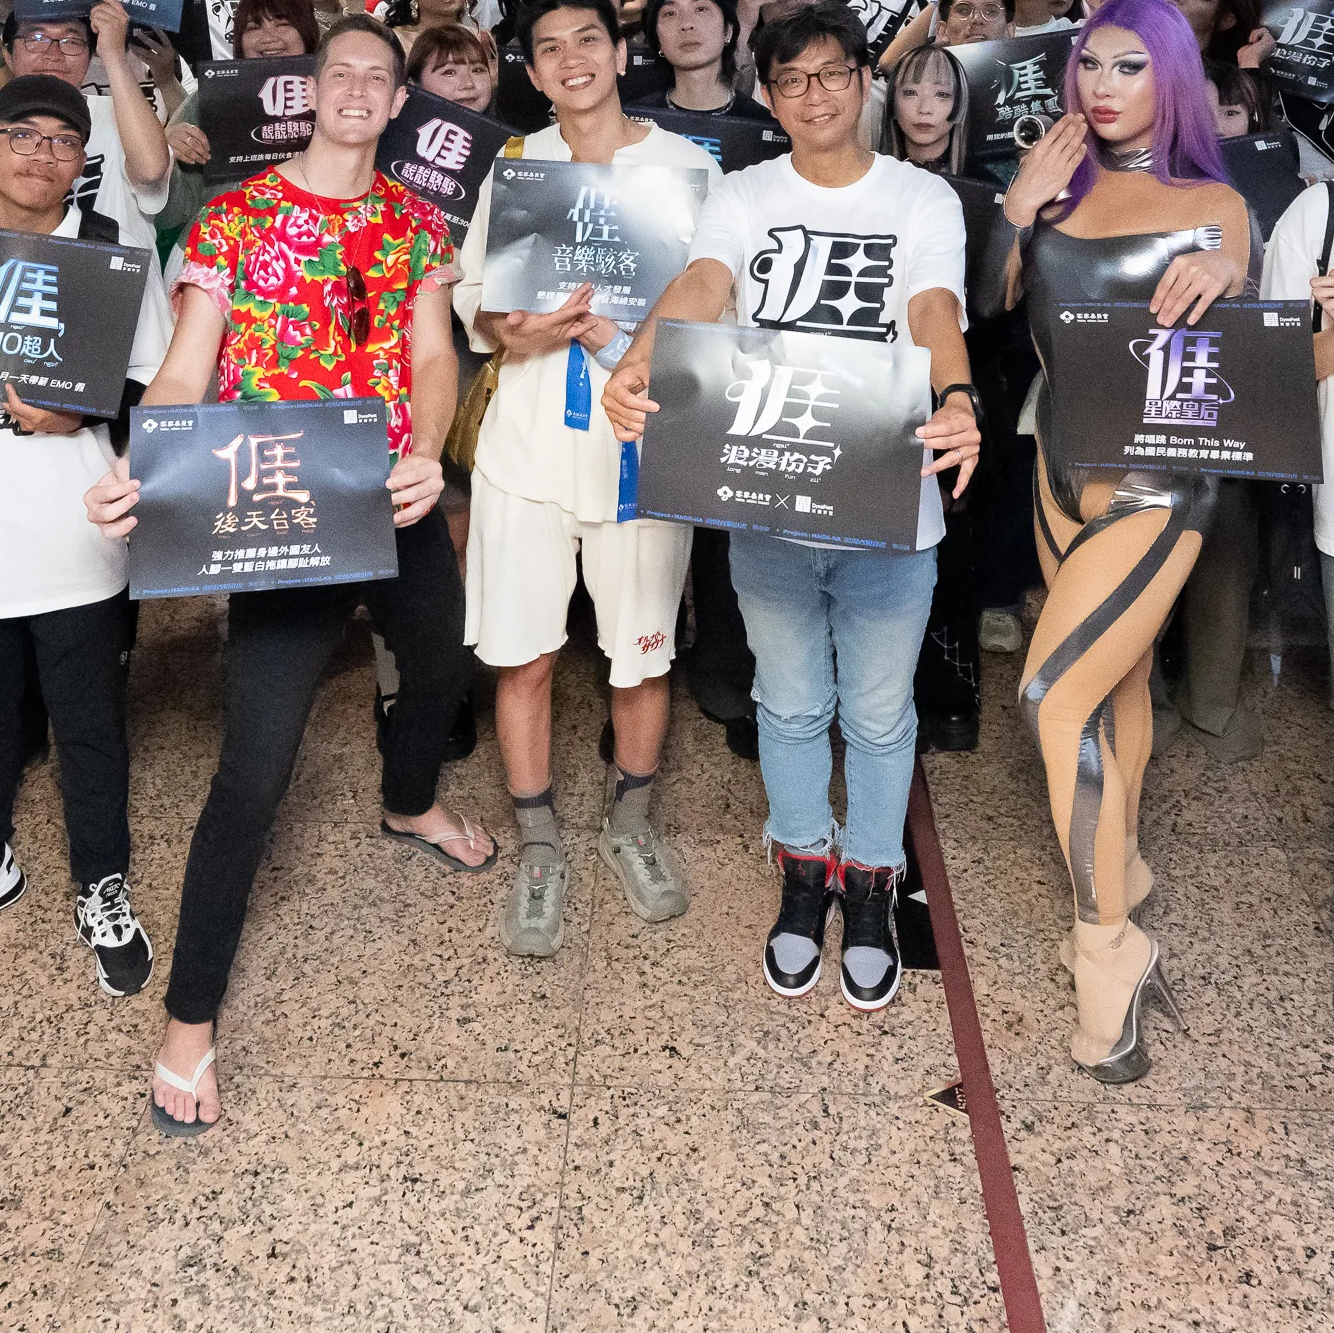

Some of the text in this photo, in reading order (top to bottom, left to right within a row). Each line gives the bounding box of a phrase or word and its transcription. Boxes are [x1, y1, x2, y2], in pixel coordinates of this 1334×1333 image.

[552, 244, 640, 277] 音樂駭客
[557, 281, 632, 295] 支持人才發展
[50, 379, 72, 390] EMO
[74, 381, 86, 393] 假
[1143, 400, 1219, 422] 星際皇后
[1170, 435, 1194, 447] Born
[1198, 437, 1220, 448] This
[1223, 439, 1246, 450] Way
[720, 443, 833, 476] 浪漫份子
[211, 505, 318, 535] 後天台客
